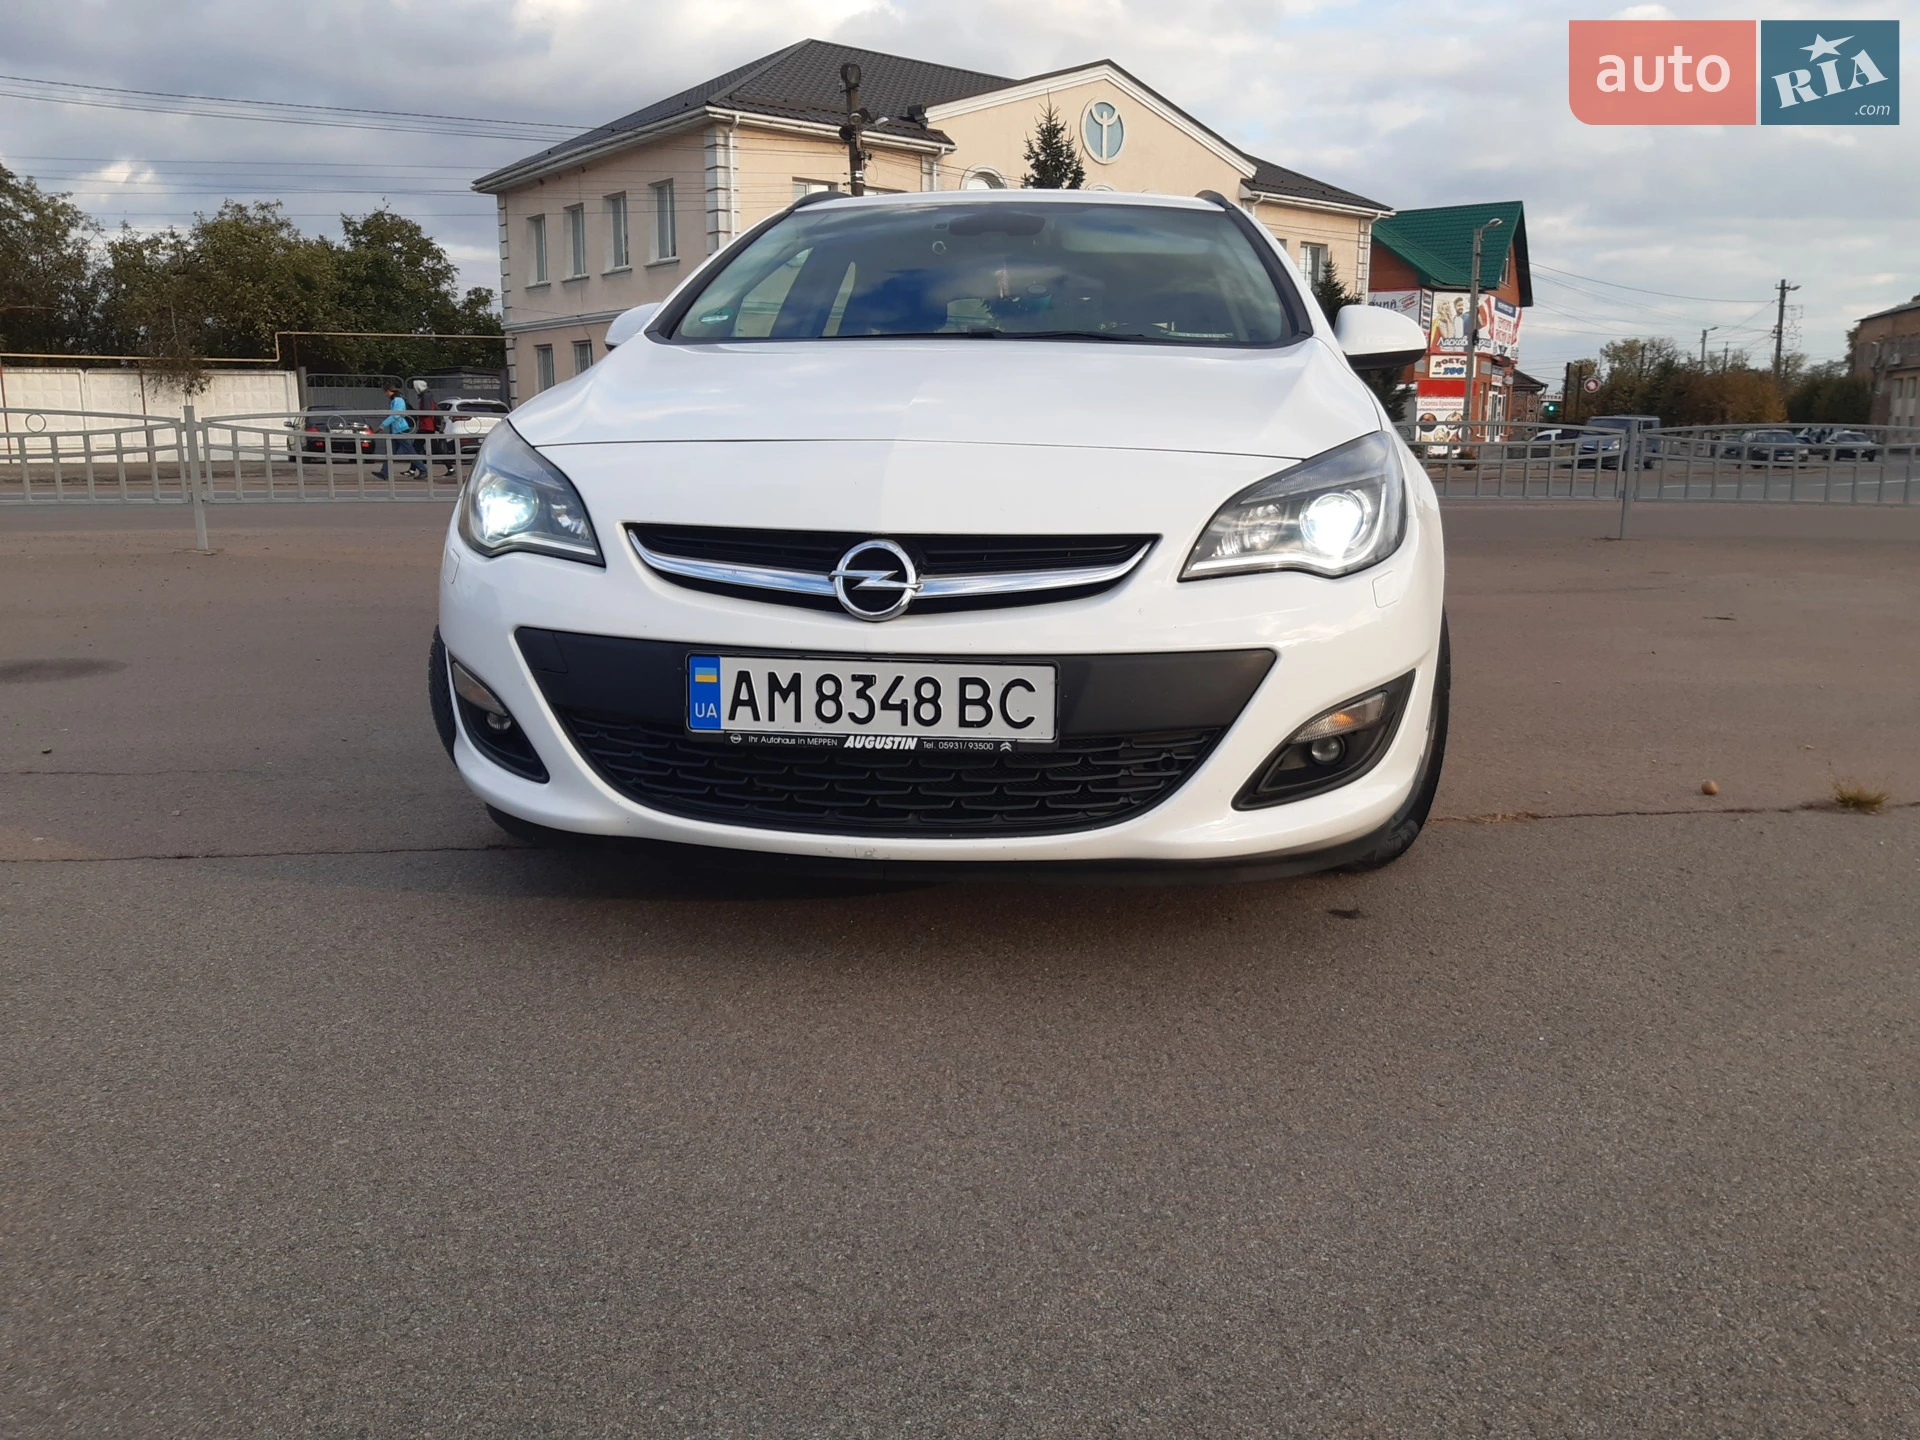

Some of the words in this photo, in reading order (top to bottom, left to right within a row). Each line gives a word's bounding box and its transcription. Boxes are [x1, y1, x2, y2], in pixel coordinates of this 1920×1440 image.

[1434, 357, 1467, 368] ДОКТО
[728, 670, 801, 723] AM
[815, 674, 942, 727] 8348
[958, 677, 1036, 730] BC
[695, 702, 718, 718] UA
[748, 736, 759, 744] Ihr
[760, 736, 797, 745] Autohaus
[807, 738, 838, 746] MEPPEN
[844, 735, 918, 750] AUGUSTIN
[923, 741, 937, 749] Tel.
[938, 741, 994, 750] 05931/93500
